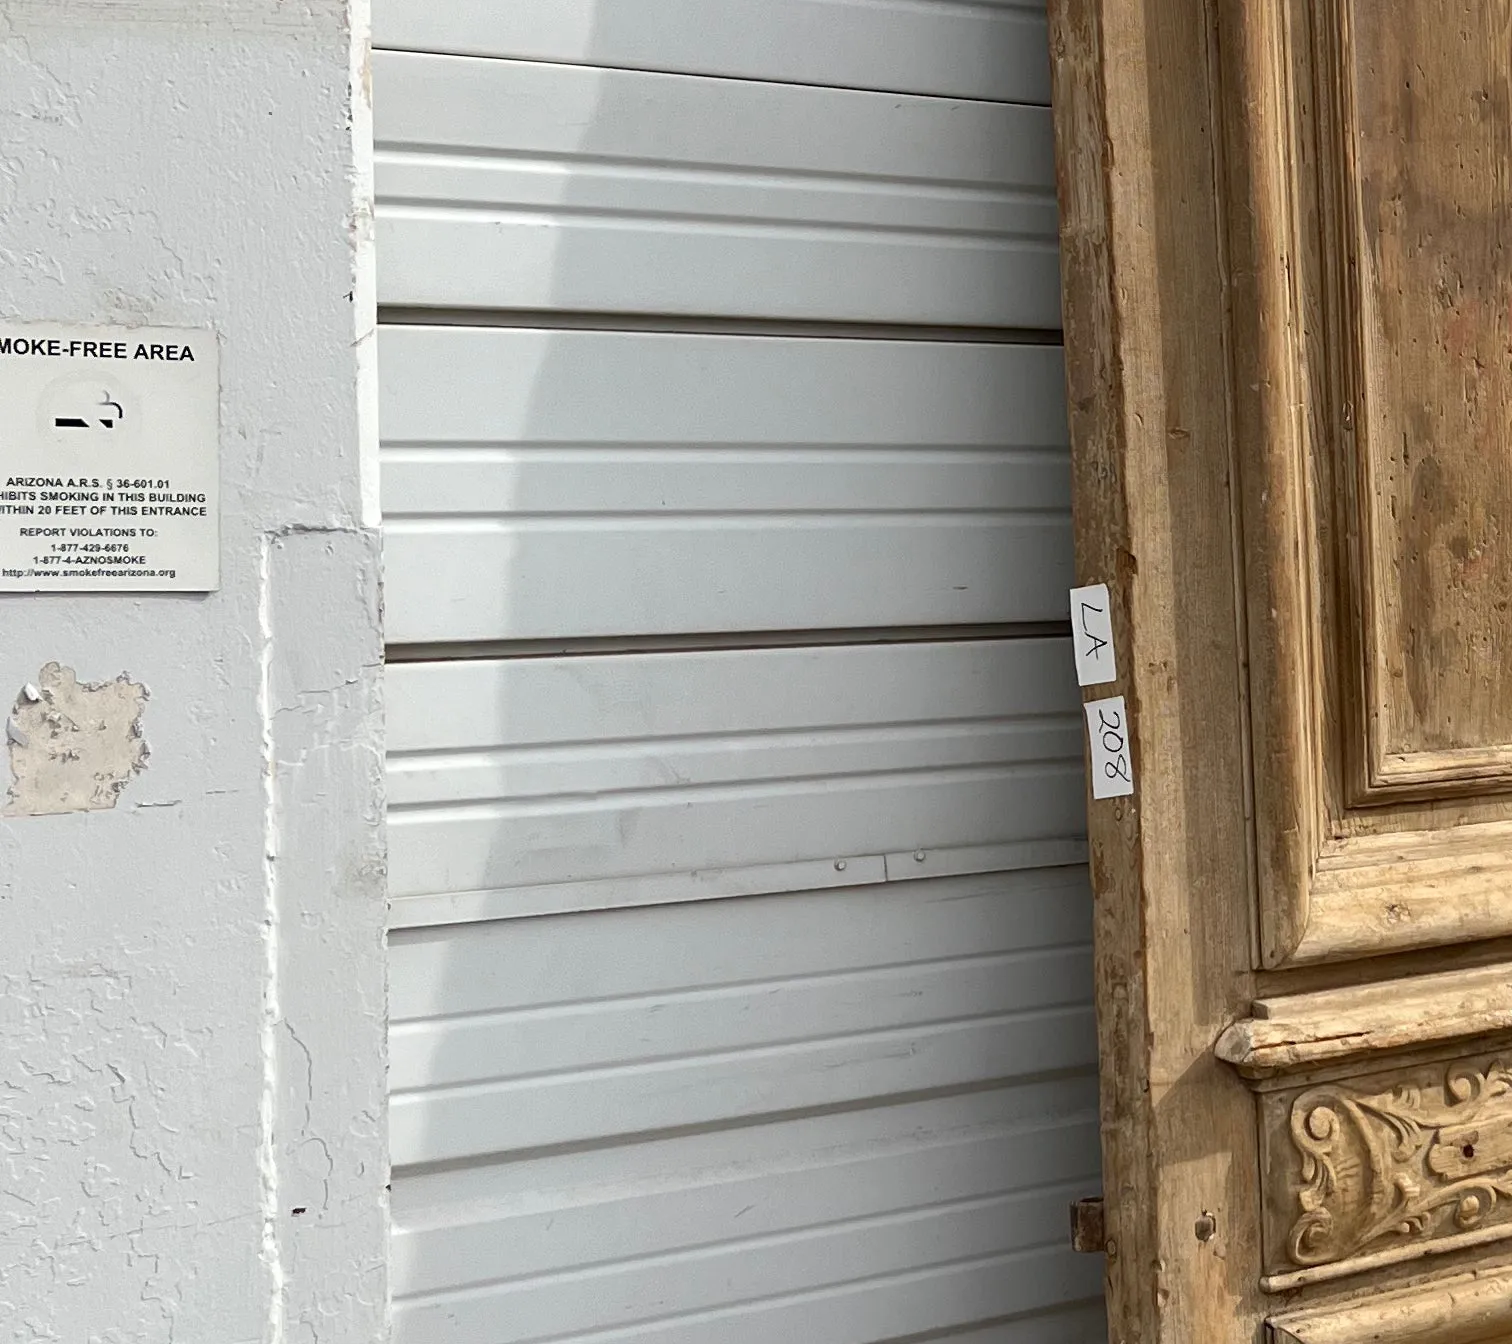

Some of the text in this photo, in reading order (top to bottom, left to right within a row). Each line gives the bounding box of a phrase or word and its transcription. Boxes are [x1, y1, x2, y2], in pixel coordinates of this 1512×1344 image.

[134, 343, 195, 362] AREA
[6, 478, 63, 488] ARIZONA
[67, 479, 102, 488] A.R.S.
[116, 479, 170, 489] 36-601.01
[40, 492, 99, 502] SMOKING
[103, 493, 115, 502] IN
[118, 493, 145, 502] THIS
[149, 493, 206, 503] BUILDING
[0, 505, 207, 516] ITHIN 20 FEET OF THIS ENTRANCE
[20, 528, 158, 537] REPORT VIOLATIONS TO:
[33, 556, 146, 565] 1-877-4-AZNOSMOKE
[2, 568, 176, 578] http://www.smokefreearizona.org
[1081, 602, 1108, 661] LA
[1098, 708, 1132, 784] 208
